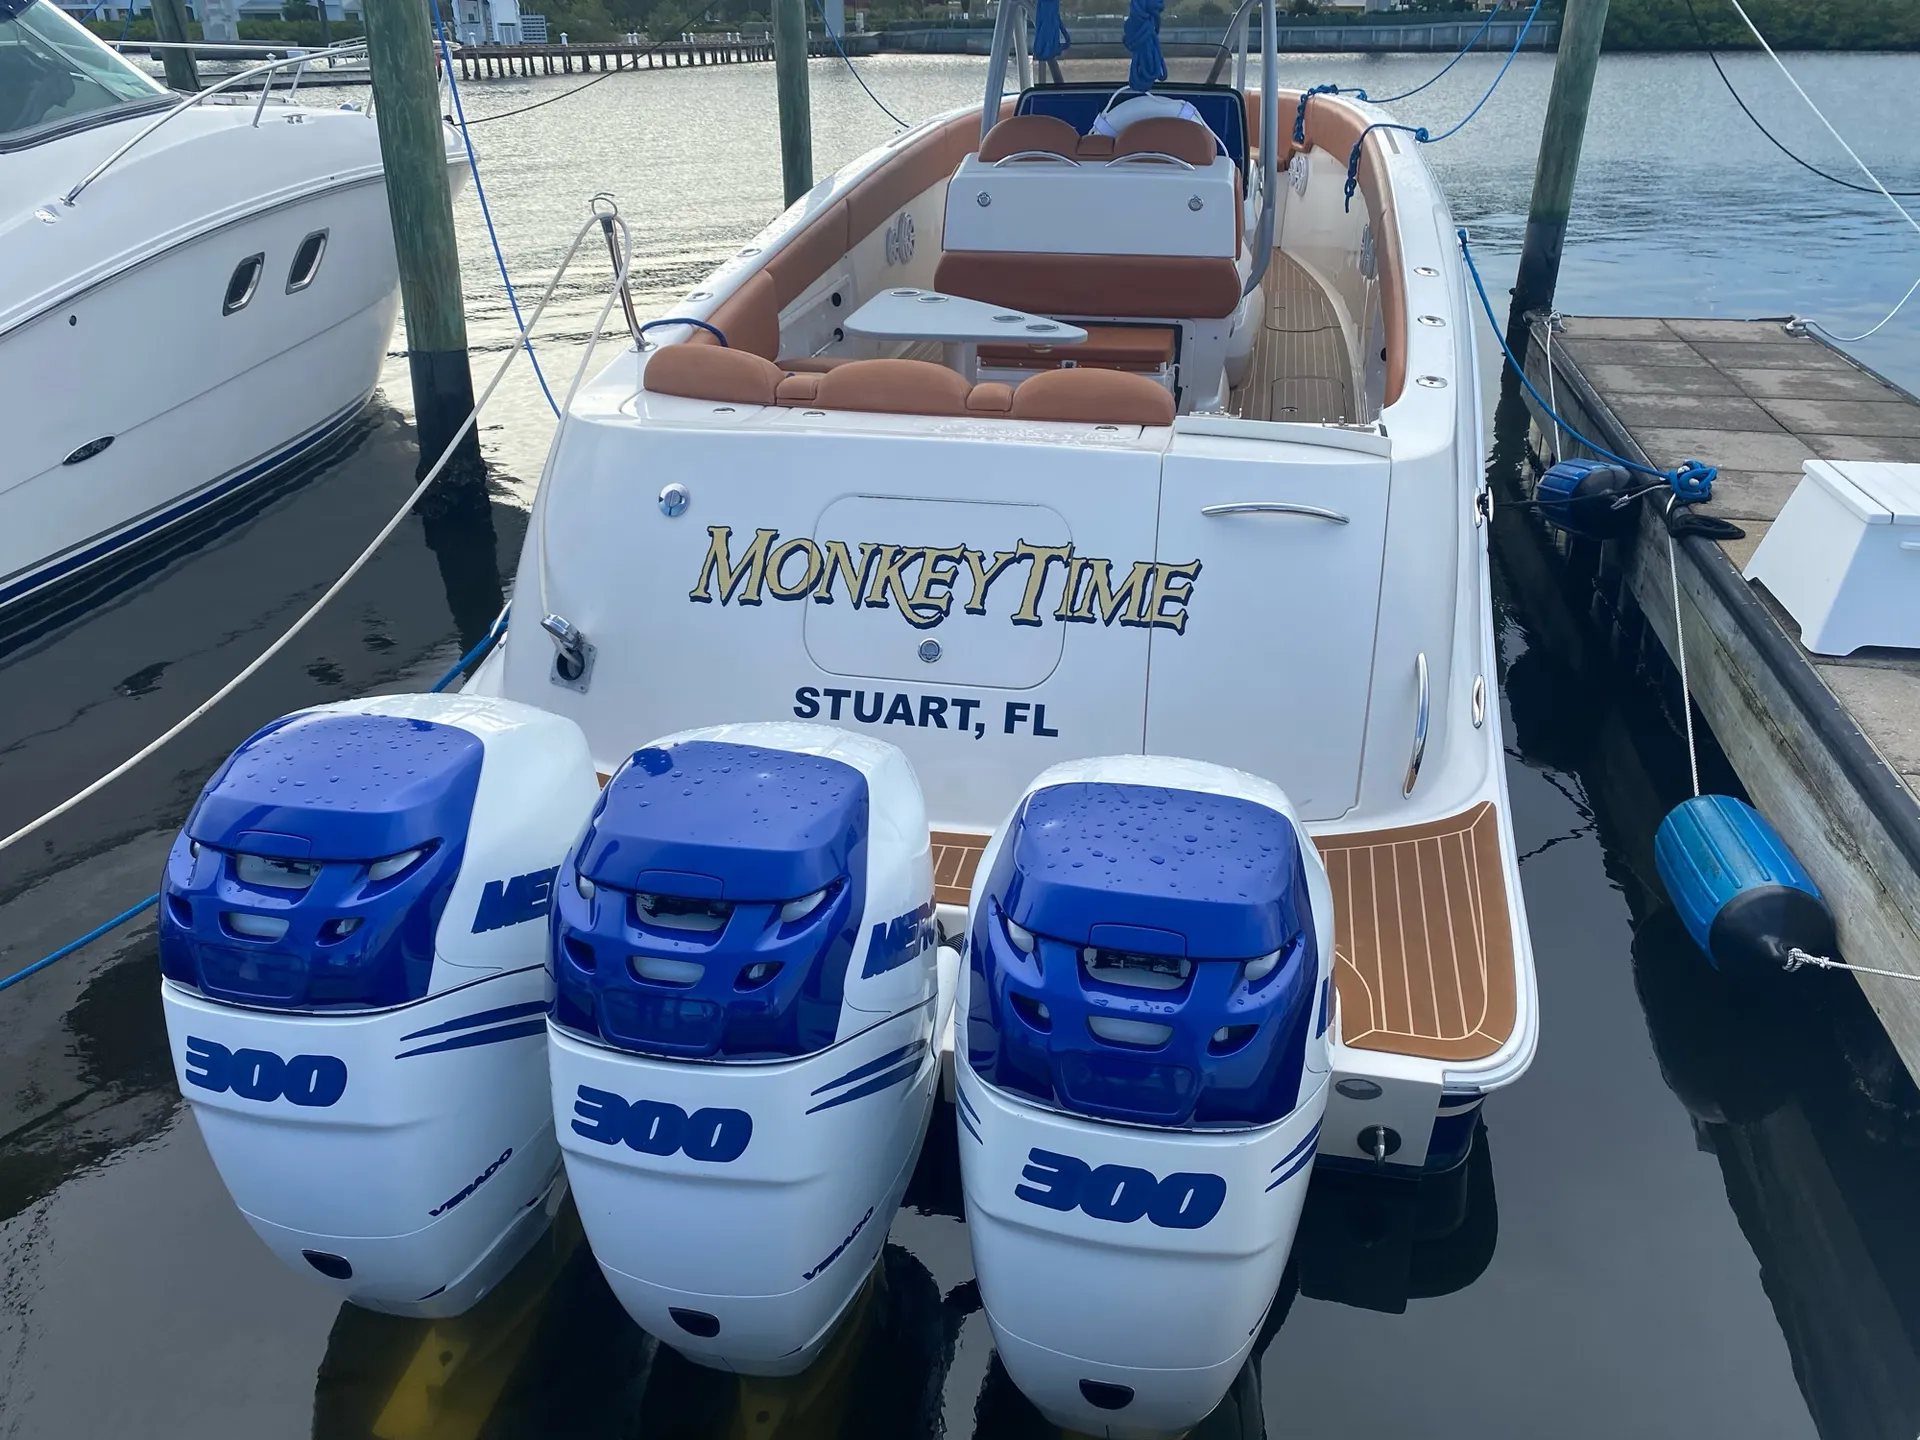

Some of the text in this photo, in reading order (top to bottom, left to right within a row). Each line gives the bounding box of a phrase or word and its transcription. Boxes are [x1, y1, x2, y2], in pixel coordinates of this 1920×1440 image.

[792, 687, 1059, 740] STUART, FL
[185, 1034, 348, 1108] 300
[570, 1084, 753, 1163] 300
[1014, 1147, 1227, 1229] 300
